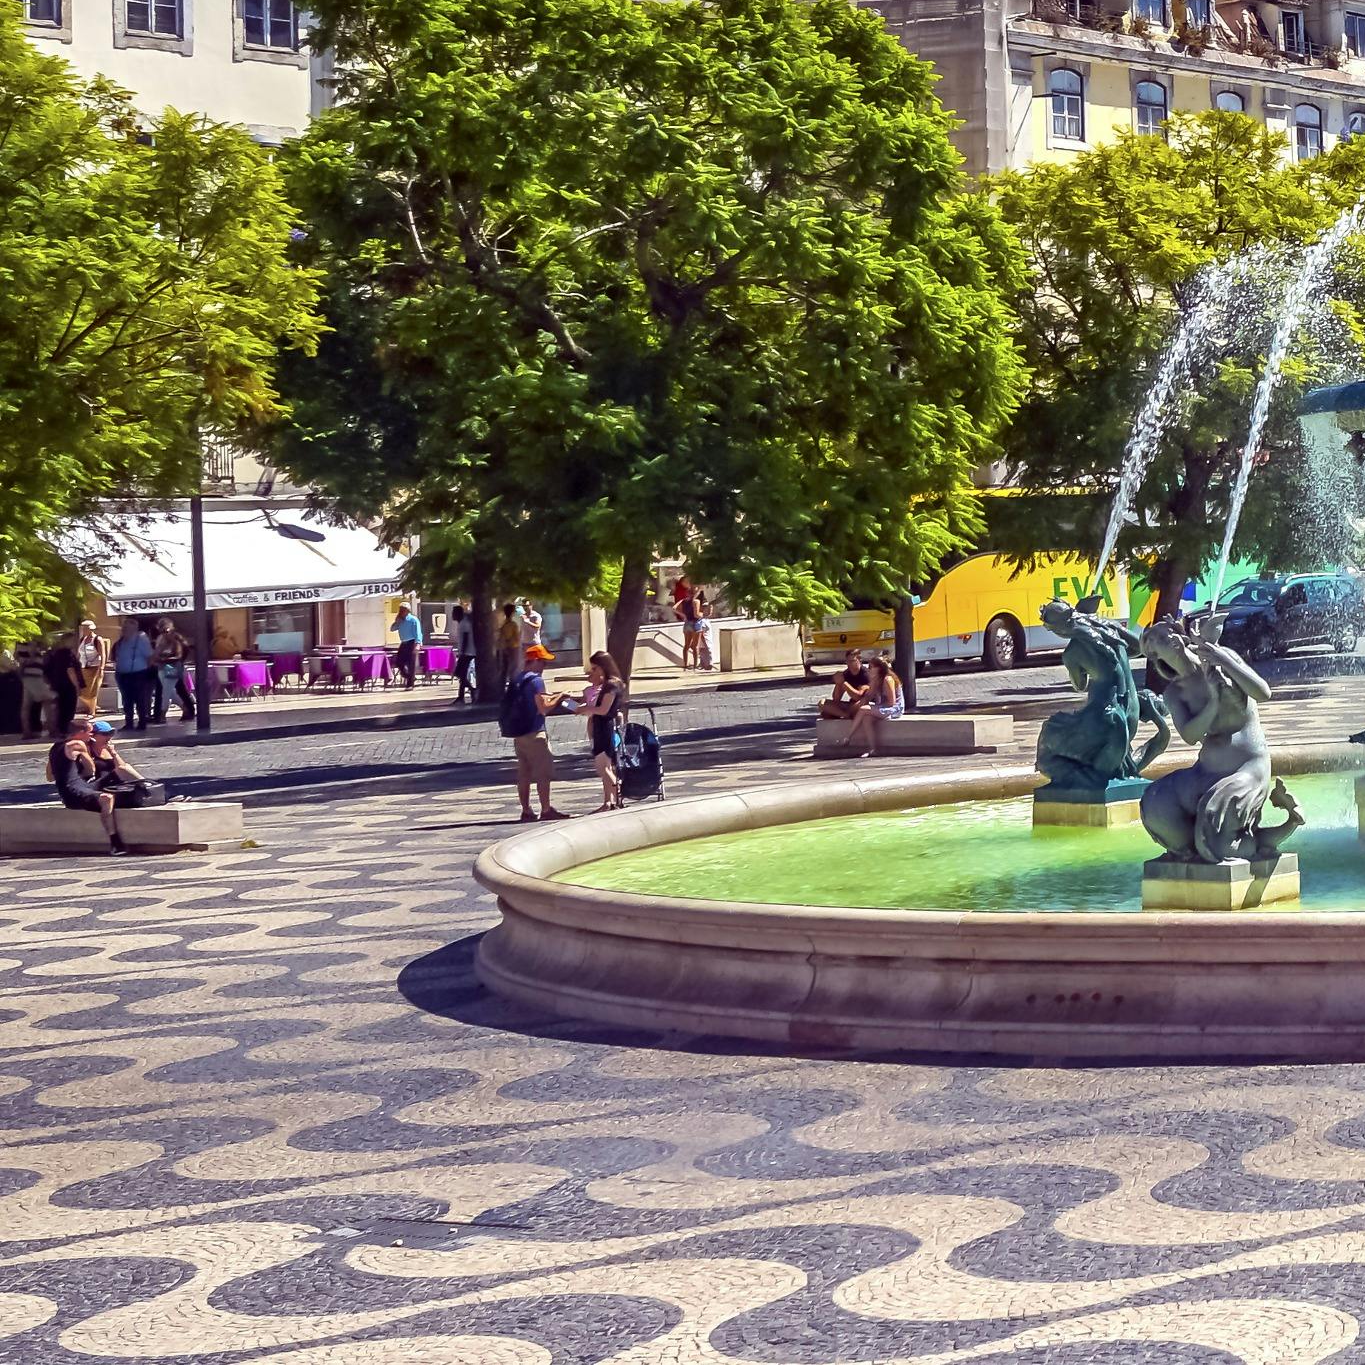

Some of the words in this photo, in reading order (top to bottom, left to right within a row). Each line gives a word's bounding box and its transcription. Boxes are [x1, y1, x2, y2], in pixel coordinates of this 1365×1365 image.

[115, 597, 188, 612] JERONYMO
[274, 589, 321, 602] FRIENDS
[361, 583, 400, 595] JERON
[1053, 574, 1114, 607] EVA
